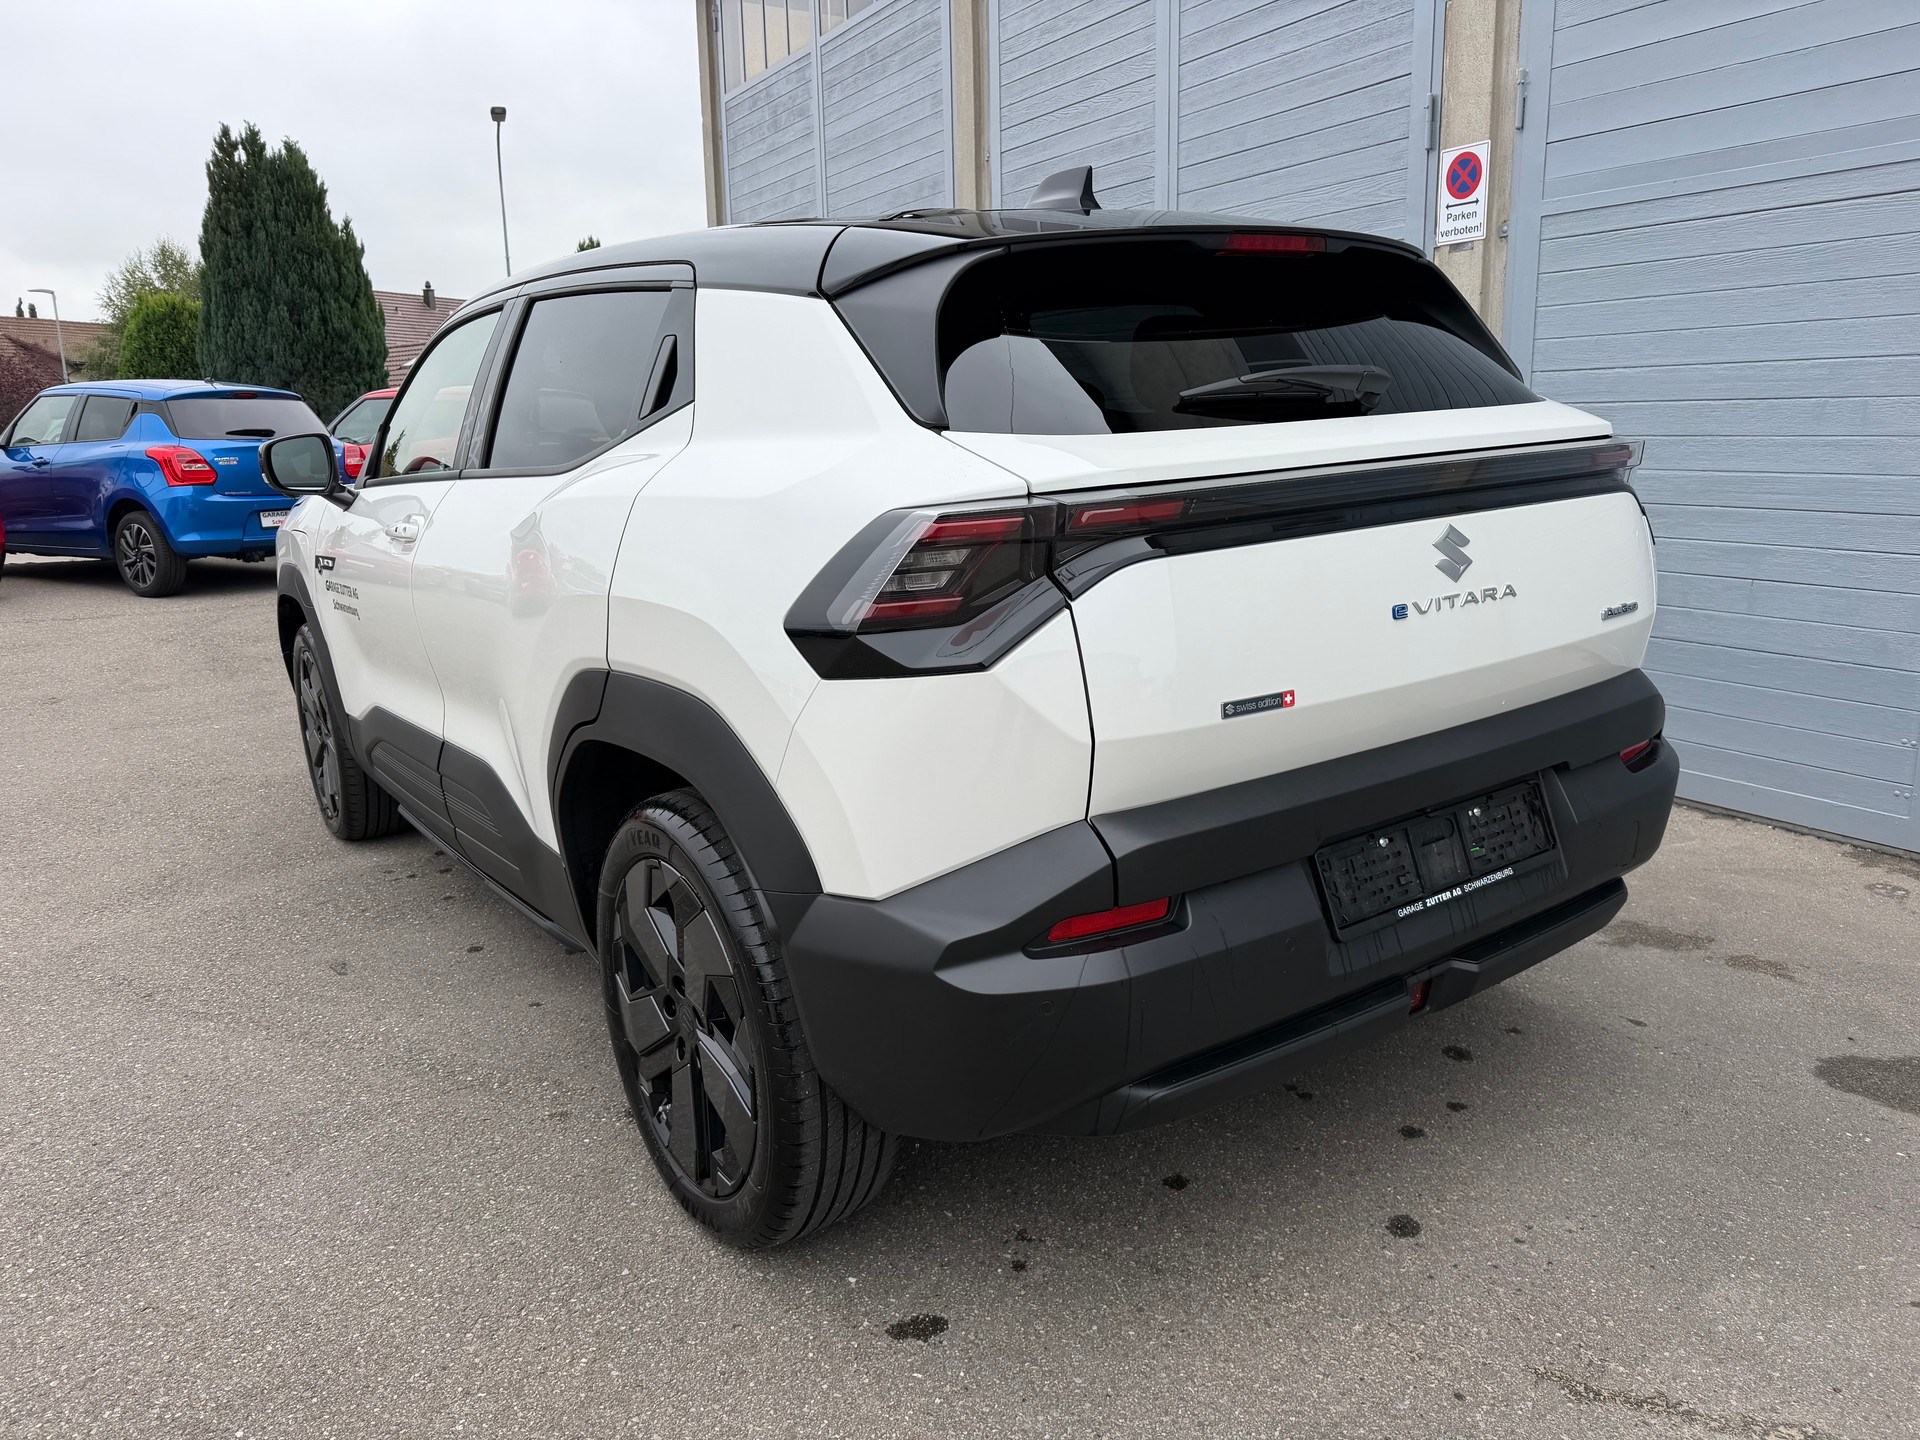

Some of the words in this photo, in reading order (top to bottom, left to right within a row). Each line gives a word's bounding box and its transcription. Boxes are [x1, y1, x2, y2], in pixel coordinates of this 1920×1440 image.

[1446, 210, 1477, 222] Parken
[1440, 222, 1482, 237] verboten!
[1236, 702, 1257, 713] swiss
[1257, 697, 1282, 709] edition
[1397, 901, 1424, 917] GARAGE
[1425, 891, 1452, 907] ZUTTER
[1452, 887, 1462, 897] AG
[1463, 867, 1514, 892] SCHWARZENBURG
